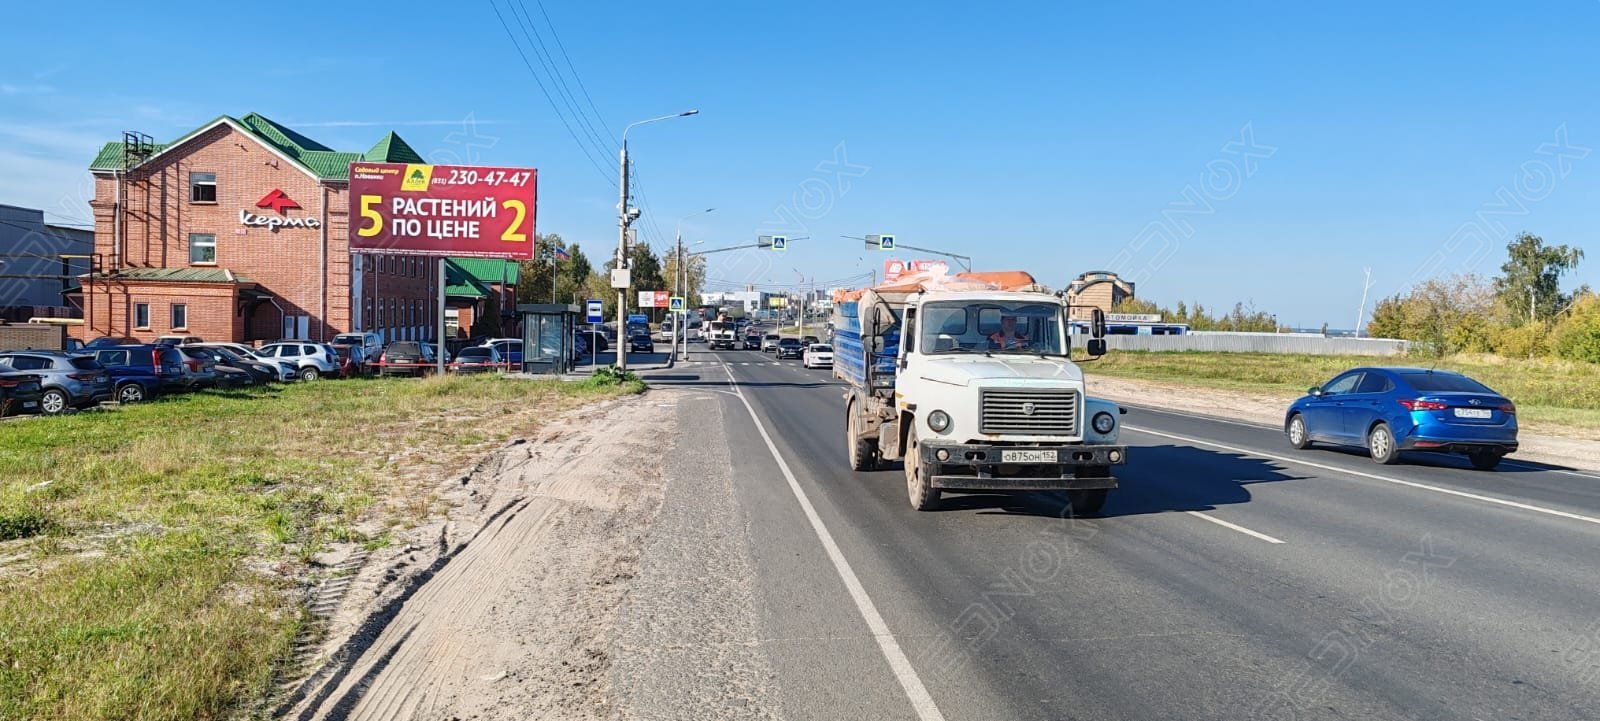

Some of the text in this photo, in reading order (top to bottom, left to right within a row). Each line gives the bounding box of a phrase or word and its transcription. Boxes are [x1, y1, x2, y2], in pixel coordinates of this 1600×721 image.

[431, 169, 531, 187] (831) 230-47-47
[357, 195, 383, 237] 5
[392, 197, 496, 218] РАСТЕНИЙ
[392, 218, 480, 240] ПО ЦЕНЕ
[500, 199, 527, 242] 2
